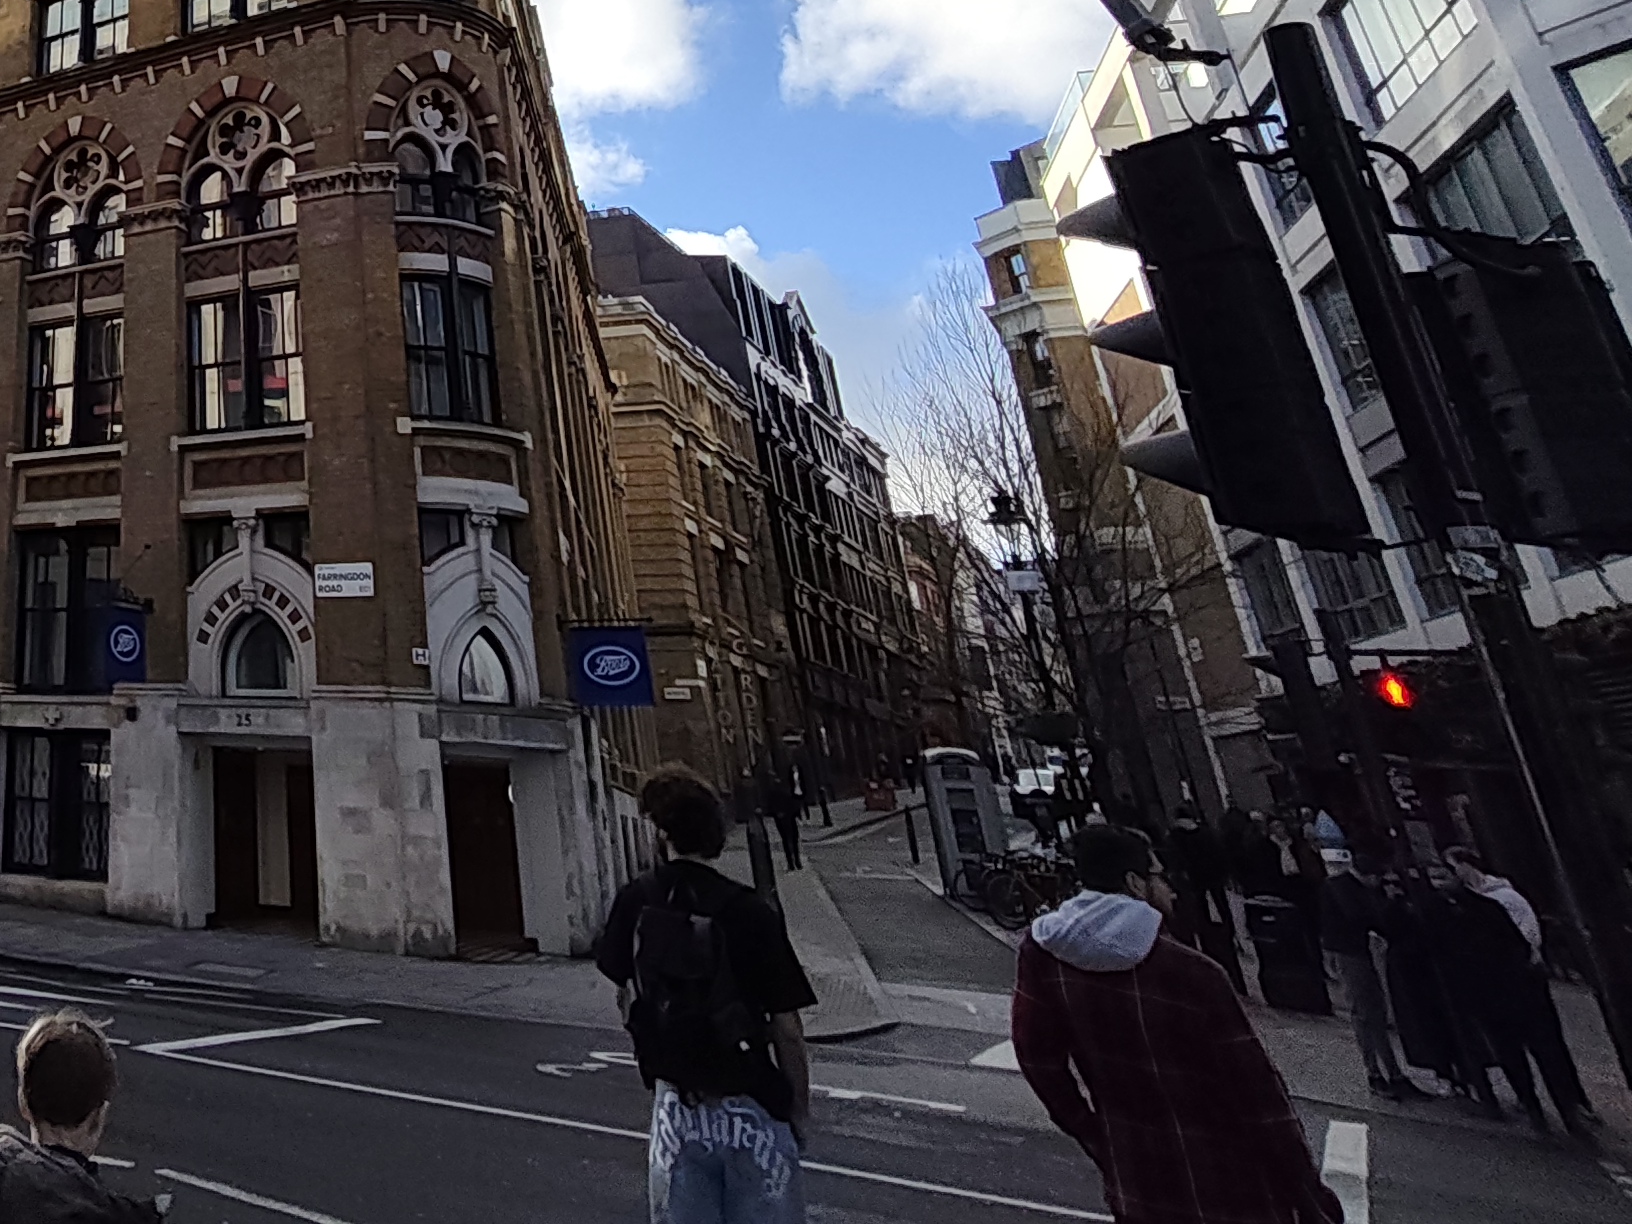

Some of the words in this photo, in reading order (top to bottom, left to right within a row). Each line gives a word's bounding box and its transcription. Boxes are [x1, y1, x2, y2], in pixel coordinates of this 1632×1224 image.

[317, 572, 372, 582] FARRINGDON
[318, 584, 343, 593] ROAD
[594, 655, 631, 676] Boots
[236, 713, 252, 727] 25
